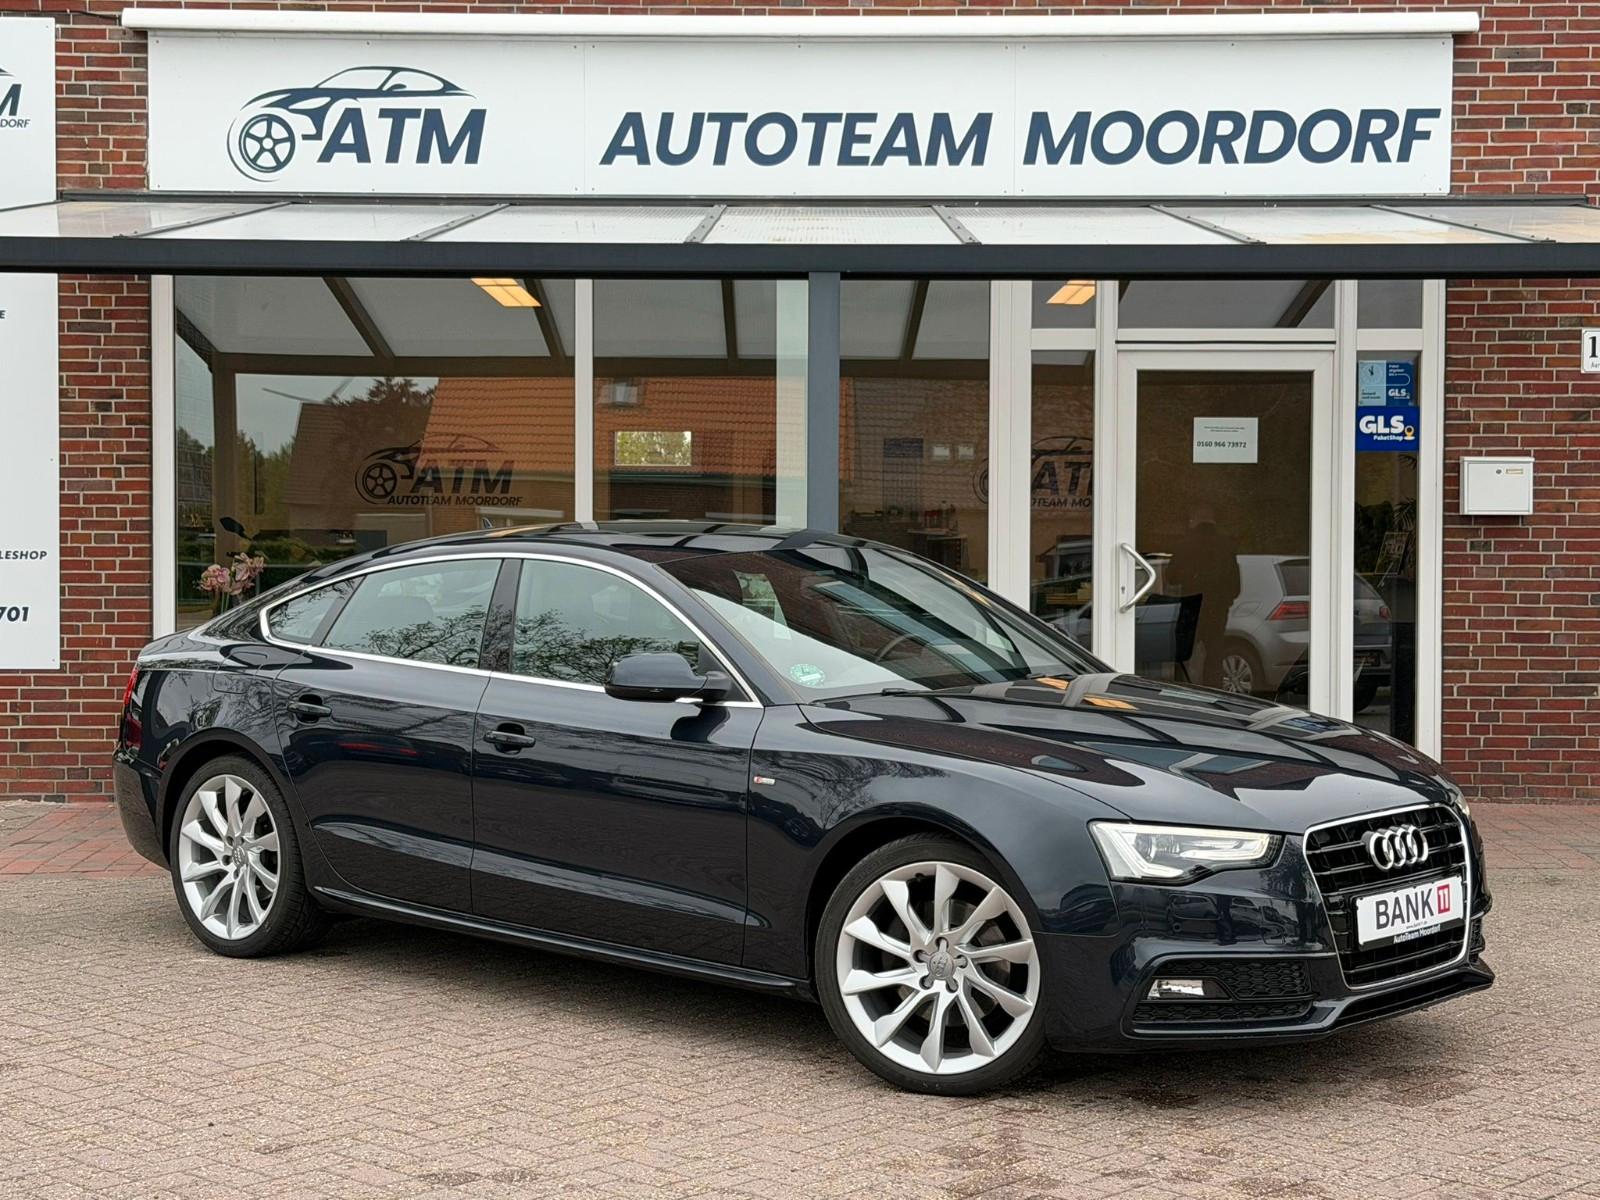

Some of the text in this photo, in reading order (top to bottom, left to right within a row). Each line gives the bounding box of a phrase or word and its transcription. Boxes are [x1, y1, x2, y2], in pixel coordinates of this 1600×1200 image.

[316, 107, 487, 164] ATM
[599, 108, 1442, 167] AUTOTEAM MOORDORF
[1359, 415, 1405, 434] GLS
[410, 460, 515, 494] ATM
[387, 496, 523, 506] AUTOTEAM MOORDORF
[1376, 888, 1434, 930] BANK
